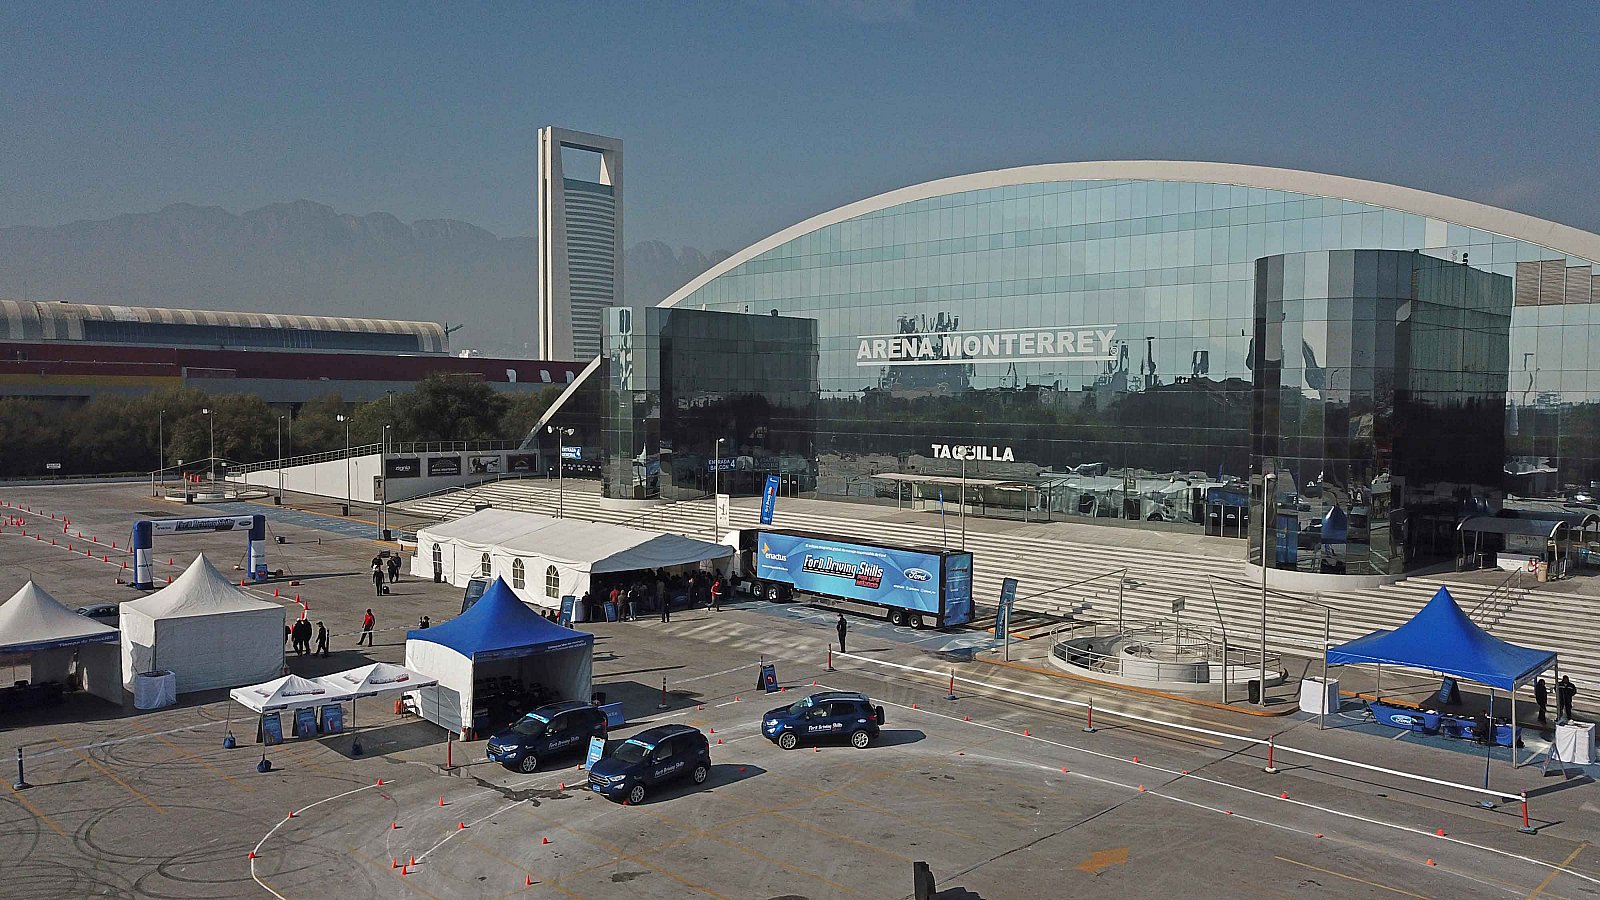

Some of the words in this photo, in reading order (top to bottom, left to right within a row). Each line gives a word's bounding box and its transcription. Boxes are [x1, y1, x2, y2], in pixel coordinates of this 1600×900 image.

[857, 337, 934, 360] ARENA
[943, 329, 1117, 357] MONTERREY
[730, 459, 736, 469] 4
[765, 552, 787, 562] enactus
[826, 557, 857, 576] Driving
[858, 561, 884, 578] Skills
[908, 570, 927, 581] Ford
